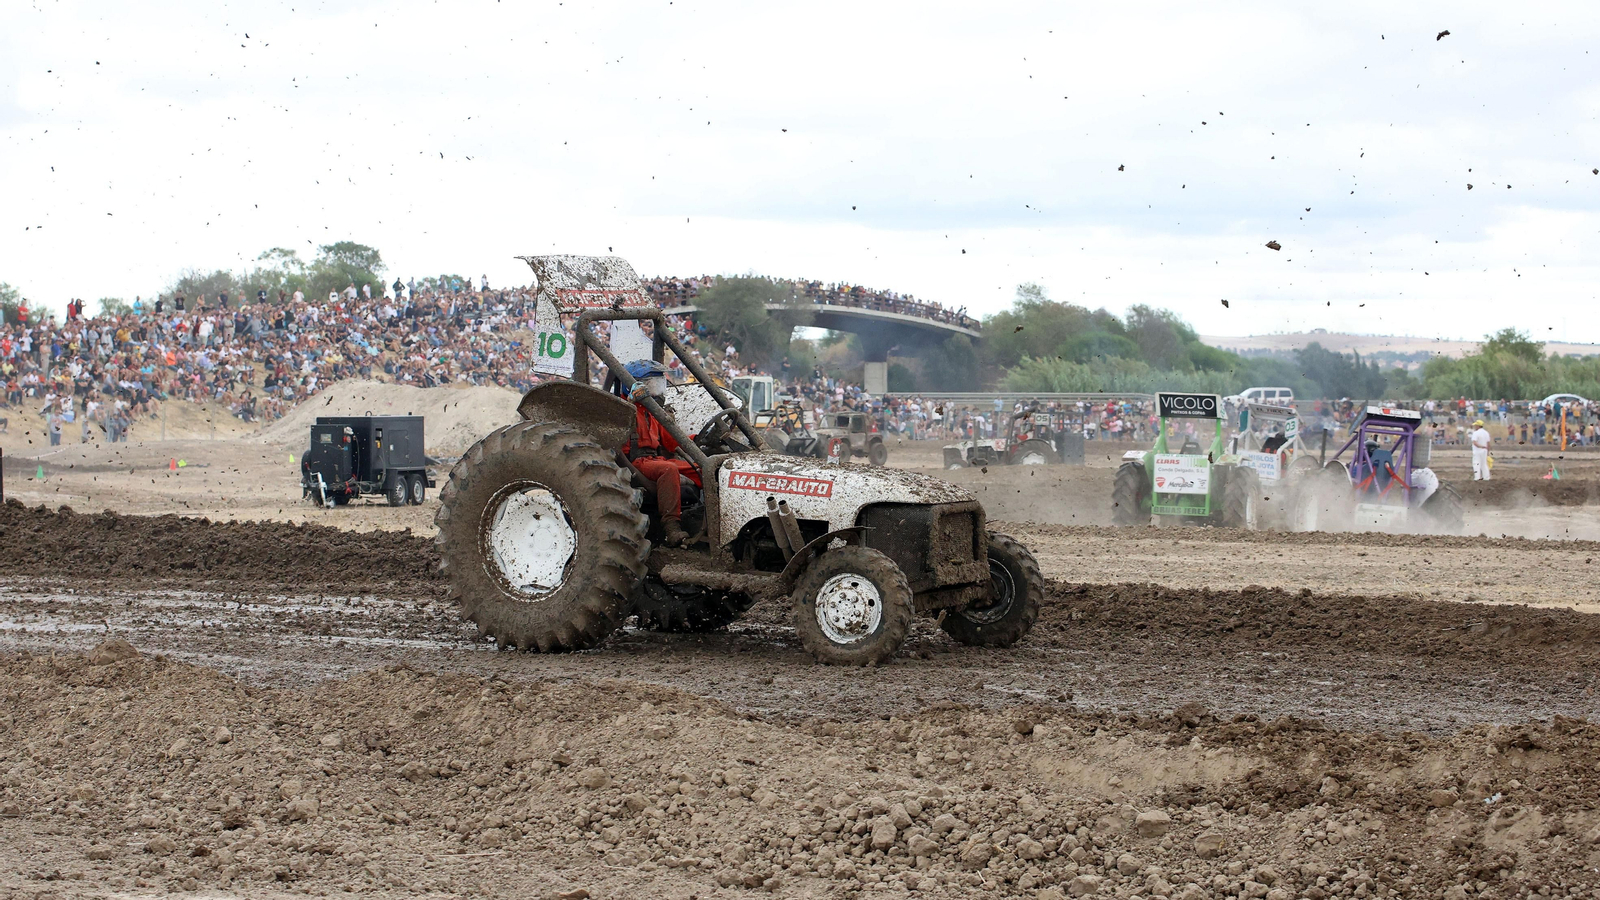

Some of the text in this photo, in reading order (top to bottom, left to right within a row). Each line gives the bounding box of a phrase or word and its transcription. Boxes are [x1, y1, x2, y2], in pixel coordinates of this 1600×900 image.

[537, 332, 566, 359] 10
[1161, 396, 1215, 410] VICOLO
[1285, 421, 1296, 431] 03
[1258, 462, 1275, 470] JOYA
[1154, 506, 1206, 515] GRUAS JEREZ
